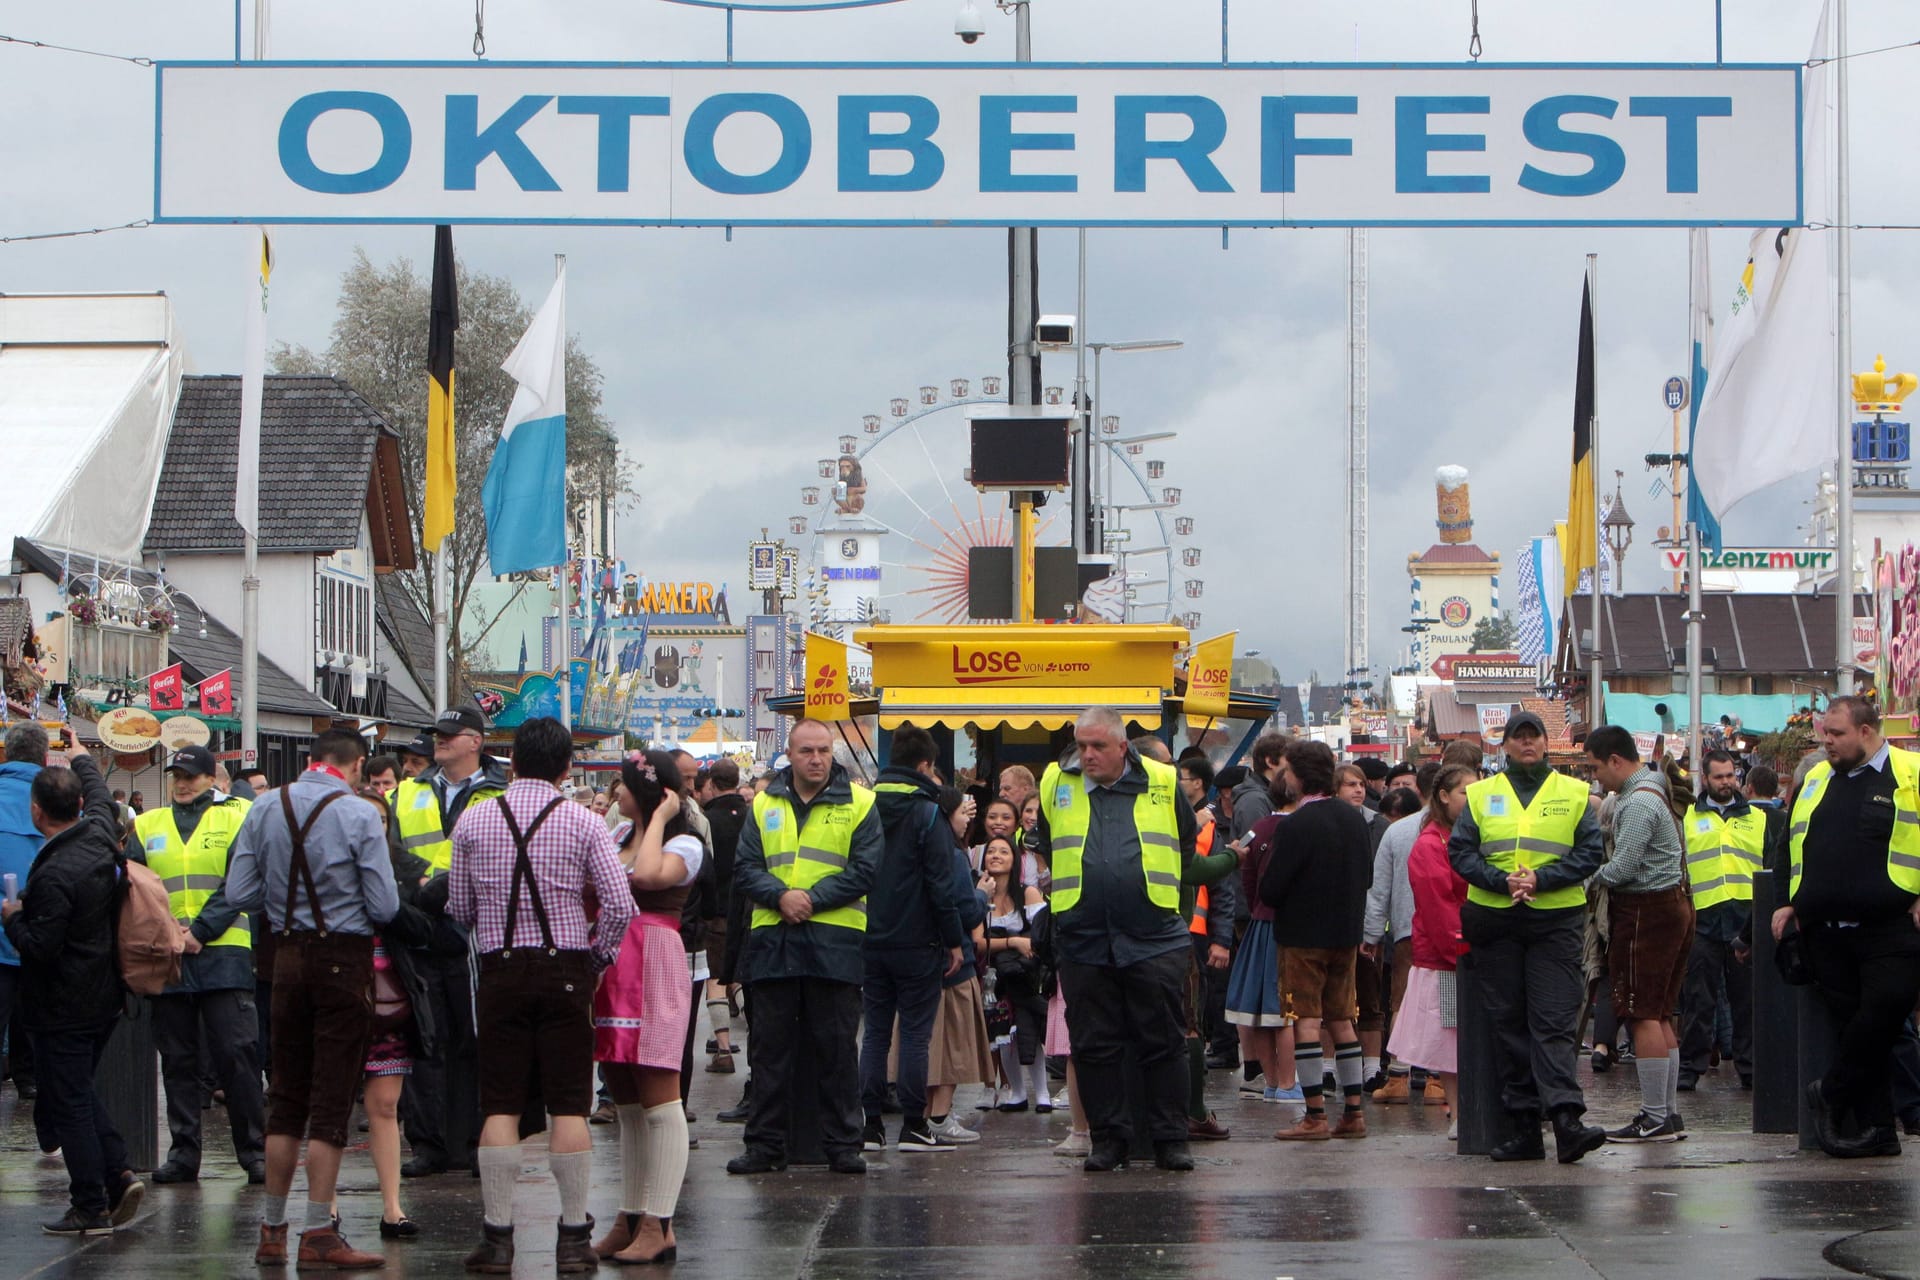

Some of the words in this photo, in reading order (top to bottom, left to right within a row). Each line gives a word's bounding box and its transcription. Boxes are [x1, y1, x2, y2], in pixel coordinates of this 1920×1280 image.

[278, 90, 1733, 195] OKTOBERFEST
[1852, 624, 1874, 644] chas
[953, 644, 1021, 673] Lose
[1023, 663, 1044, 672] VON
[1058, 663, 1090, 672] LOTTO
[1193, 663, 1228, 683] Lose
[1458, 666, 1537, 679] HAXNBRATERE
[807, 692, 845, 706] LOTTO
